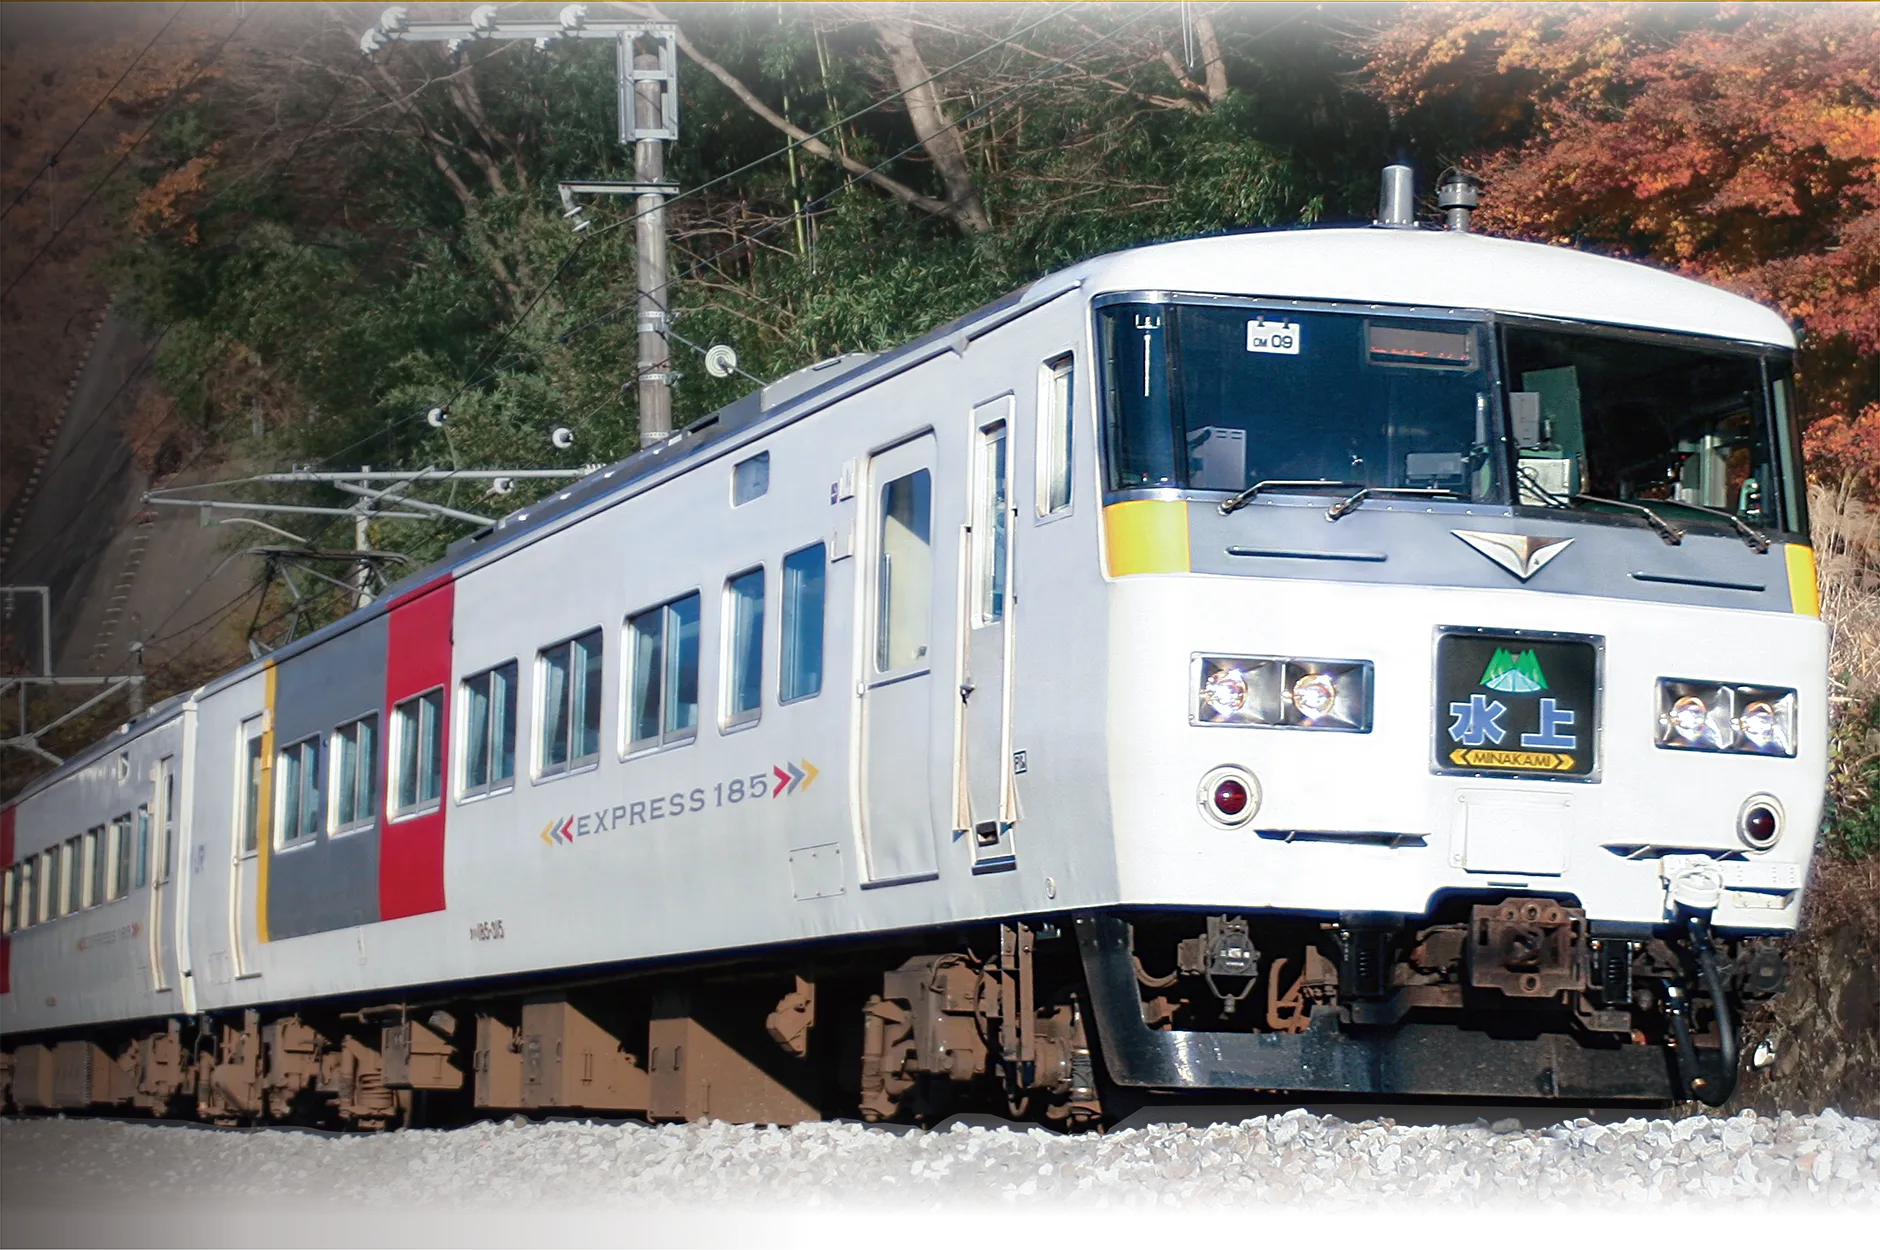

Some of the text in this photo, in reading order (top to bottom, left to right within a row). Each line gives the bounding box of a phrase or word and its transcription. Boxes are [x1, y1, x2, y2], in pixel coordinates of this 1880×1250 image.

[1271, 334, 1293, 349] 09
[1448, 694, 1576, 749] 水上
[1472, 752, 1552, 767] MINAKAMI
[576, 772, 768, 837] EXPRESS 185
